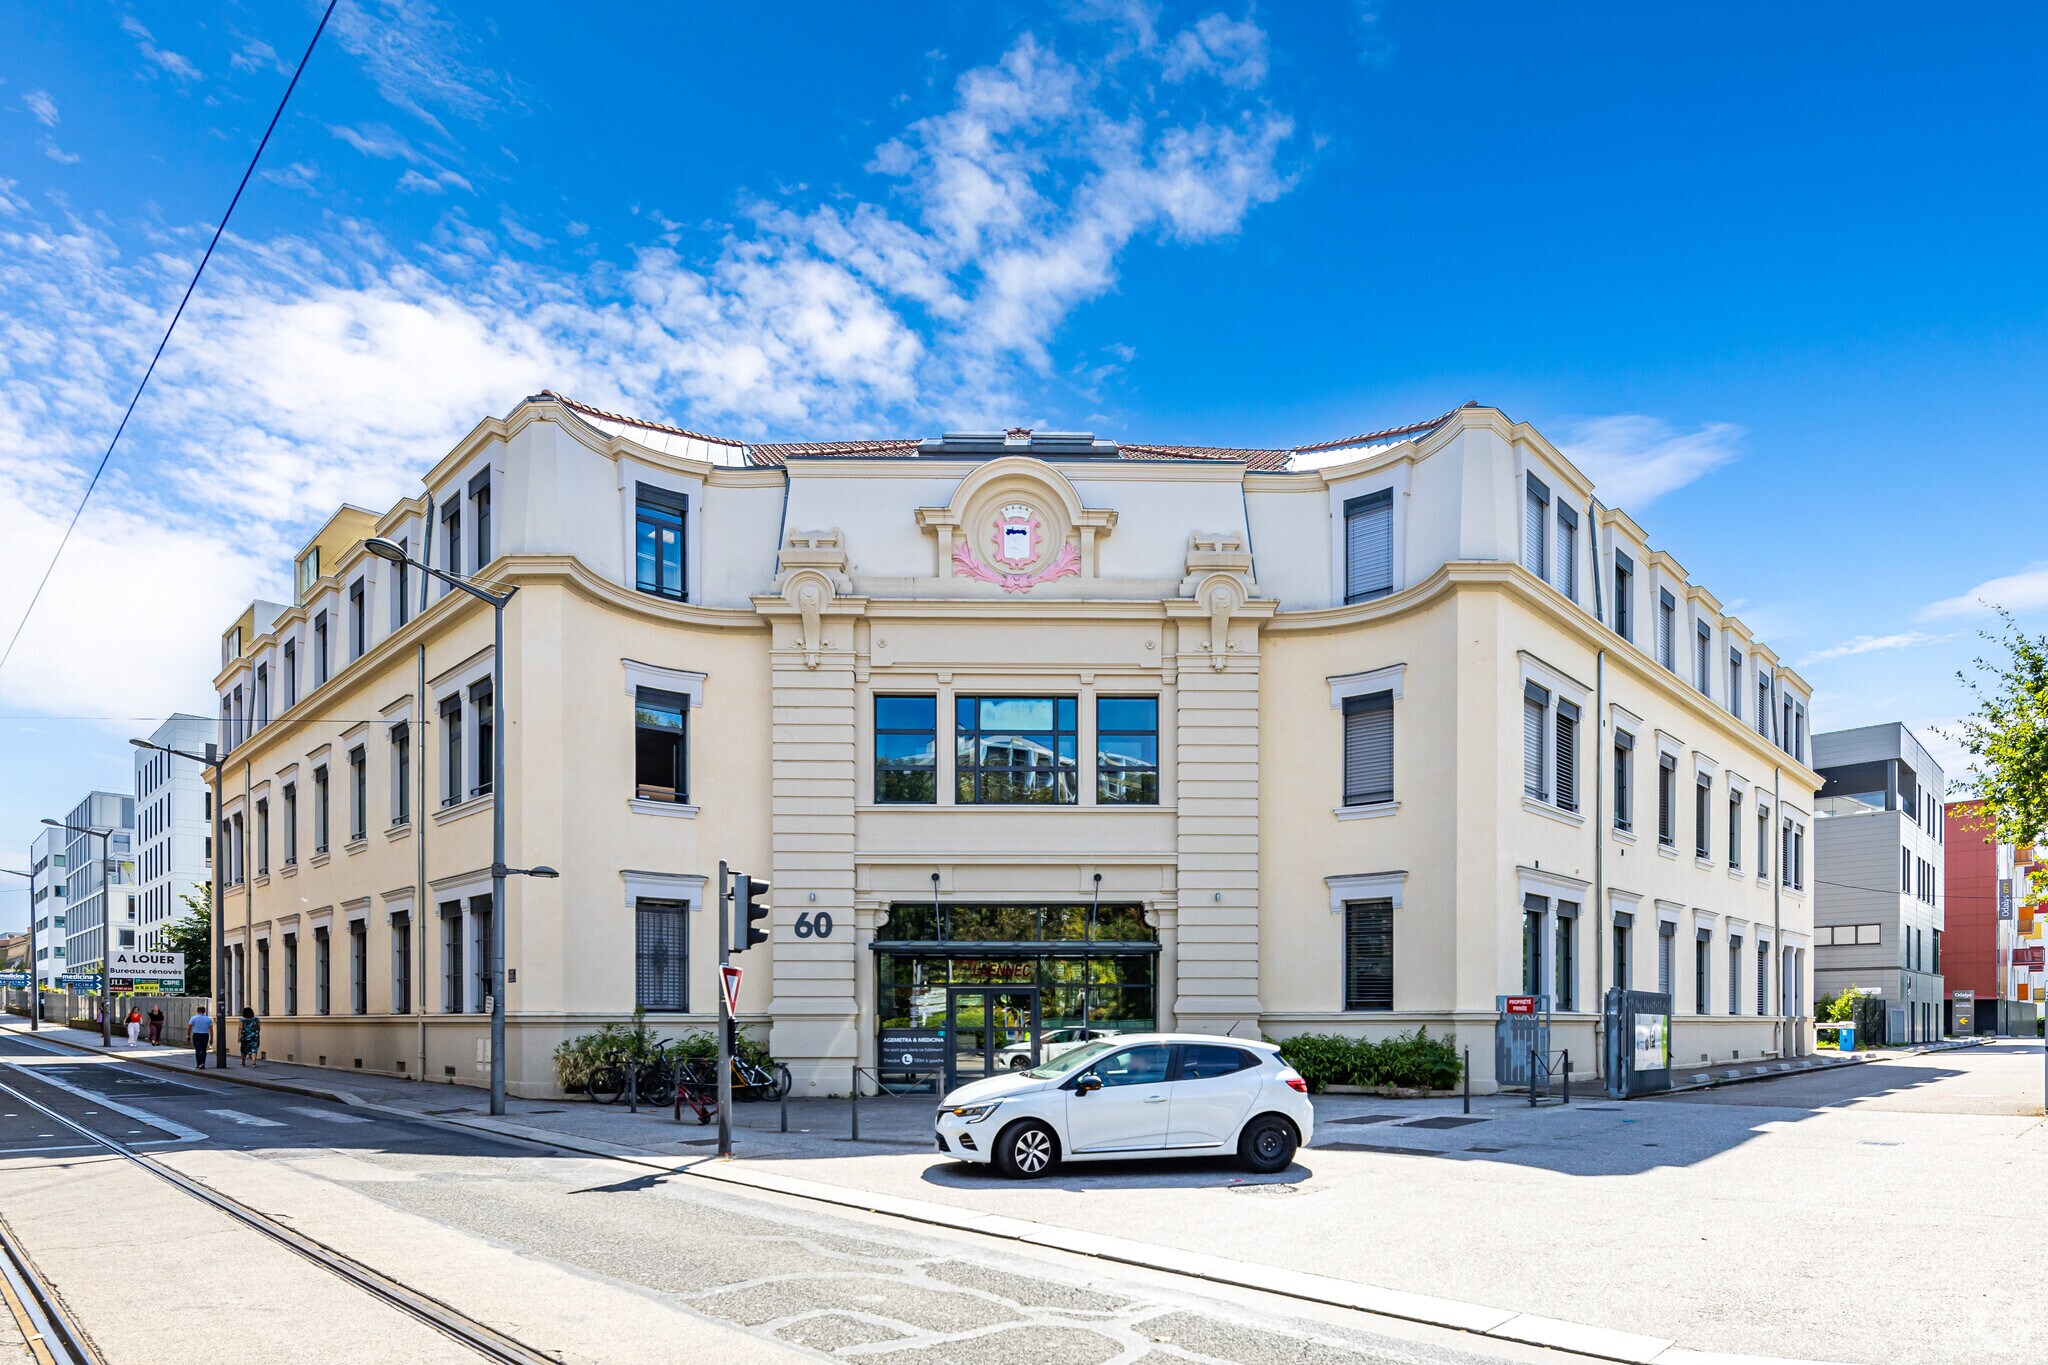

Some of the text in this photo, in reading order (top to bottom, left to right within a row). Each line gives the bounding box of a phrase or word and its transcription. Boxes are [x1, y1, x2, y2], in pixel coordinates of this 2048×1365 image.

[2001, 895, 2011, 917] Odalys
[794, 911, 833, 938] 60
[117, 954, 175, 964] A LOUER
[972, 963, 1031, 977] LAENNEC
